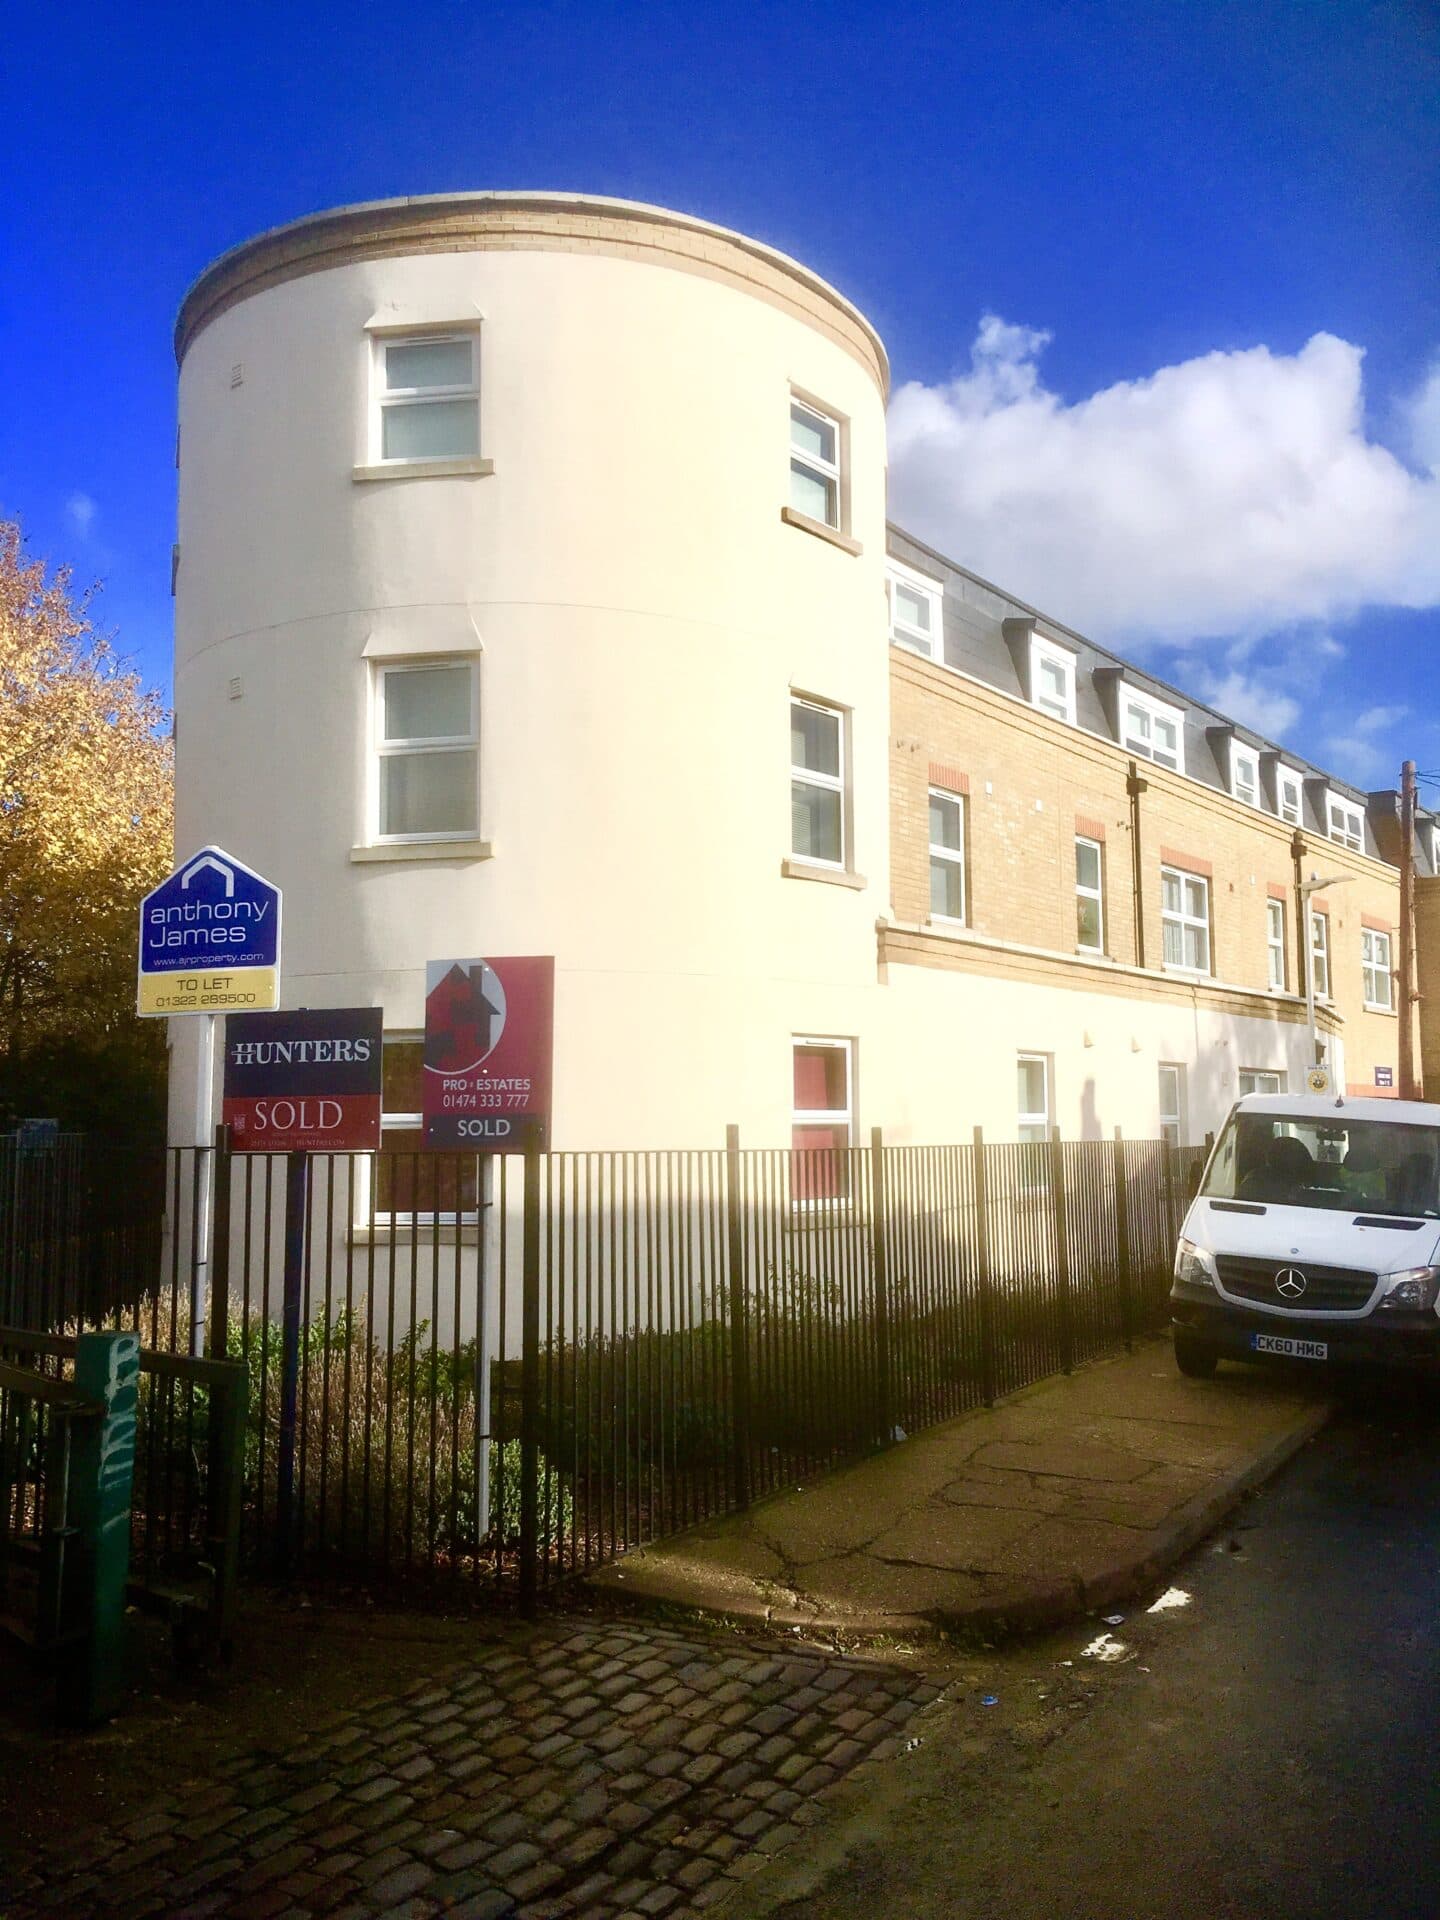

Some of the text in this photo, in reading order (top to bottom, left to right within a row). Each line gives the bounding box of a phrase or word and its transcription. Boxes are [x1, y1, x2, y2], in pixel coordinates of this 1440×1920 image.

[151, 900, 269, 924] anthony
[150, 925, 246, 948] James
[176, 977, 233, 991] TO LET
[155, 995, 197, 1007] 01322
[231, 1038, 371, 1065] HUNTERS
[442, 1079, 531, 1091] PRO ESTATES
[443, 1094, 529, 1108] 01474 333 777
[254, 1100, 343, 1130] SOLD
[457, 1119, 511, 1137] SOLD
[1257, 1336, 1325, 1357] CK60 HMG
